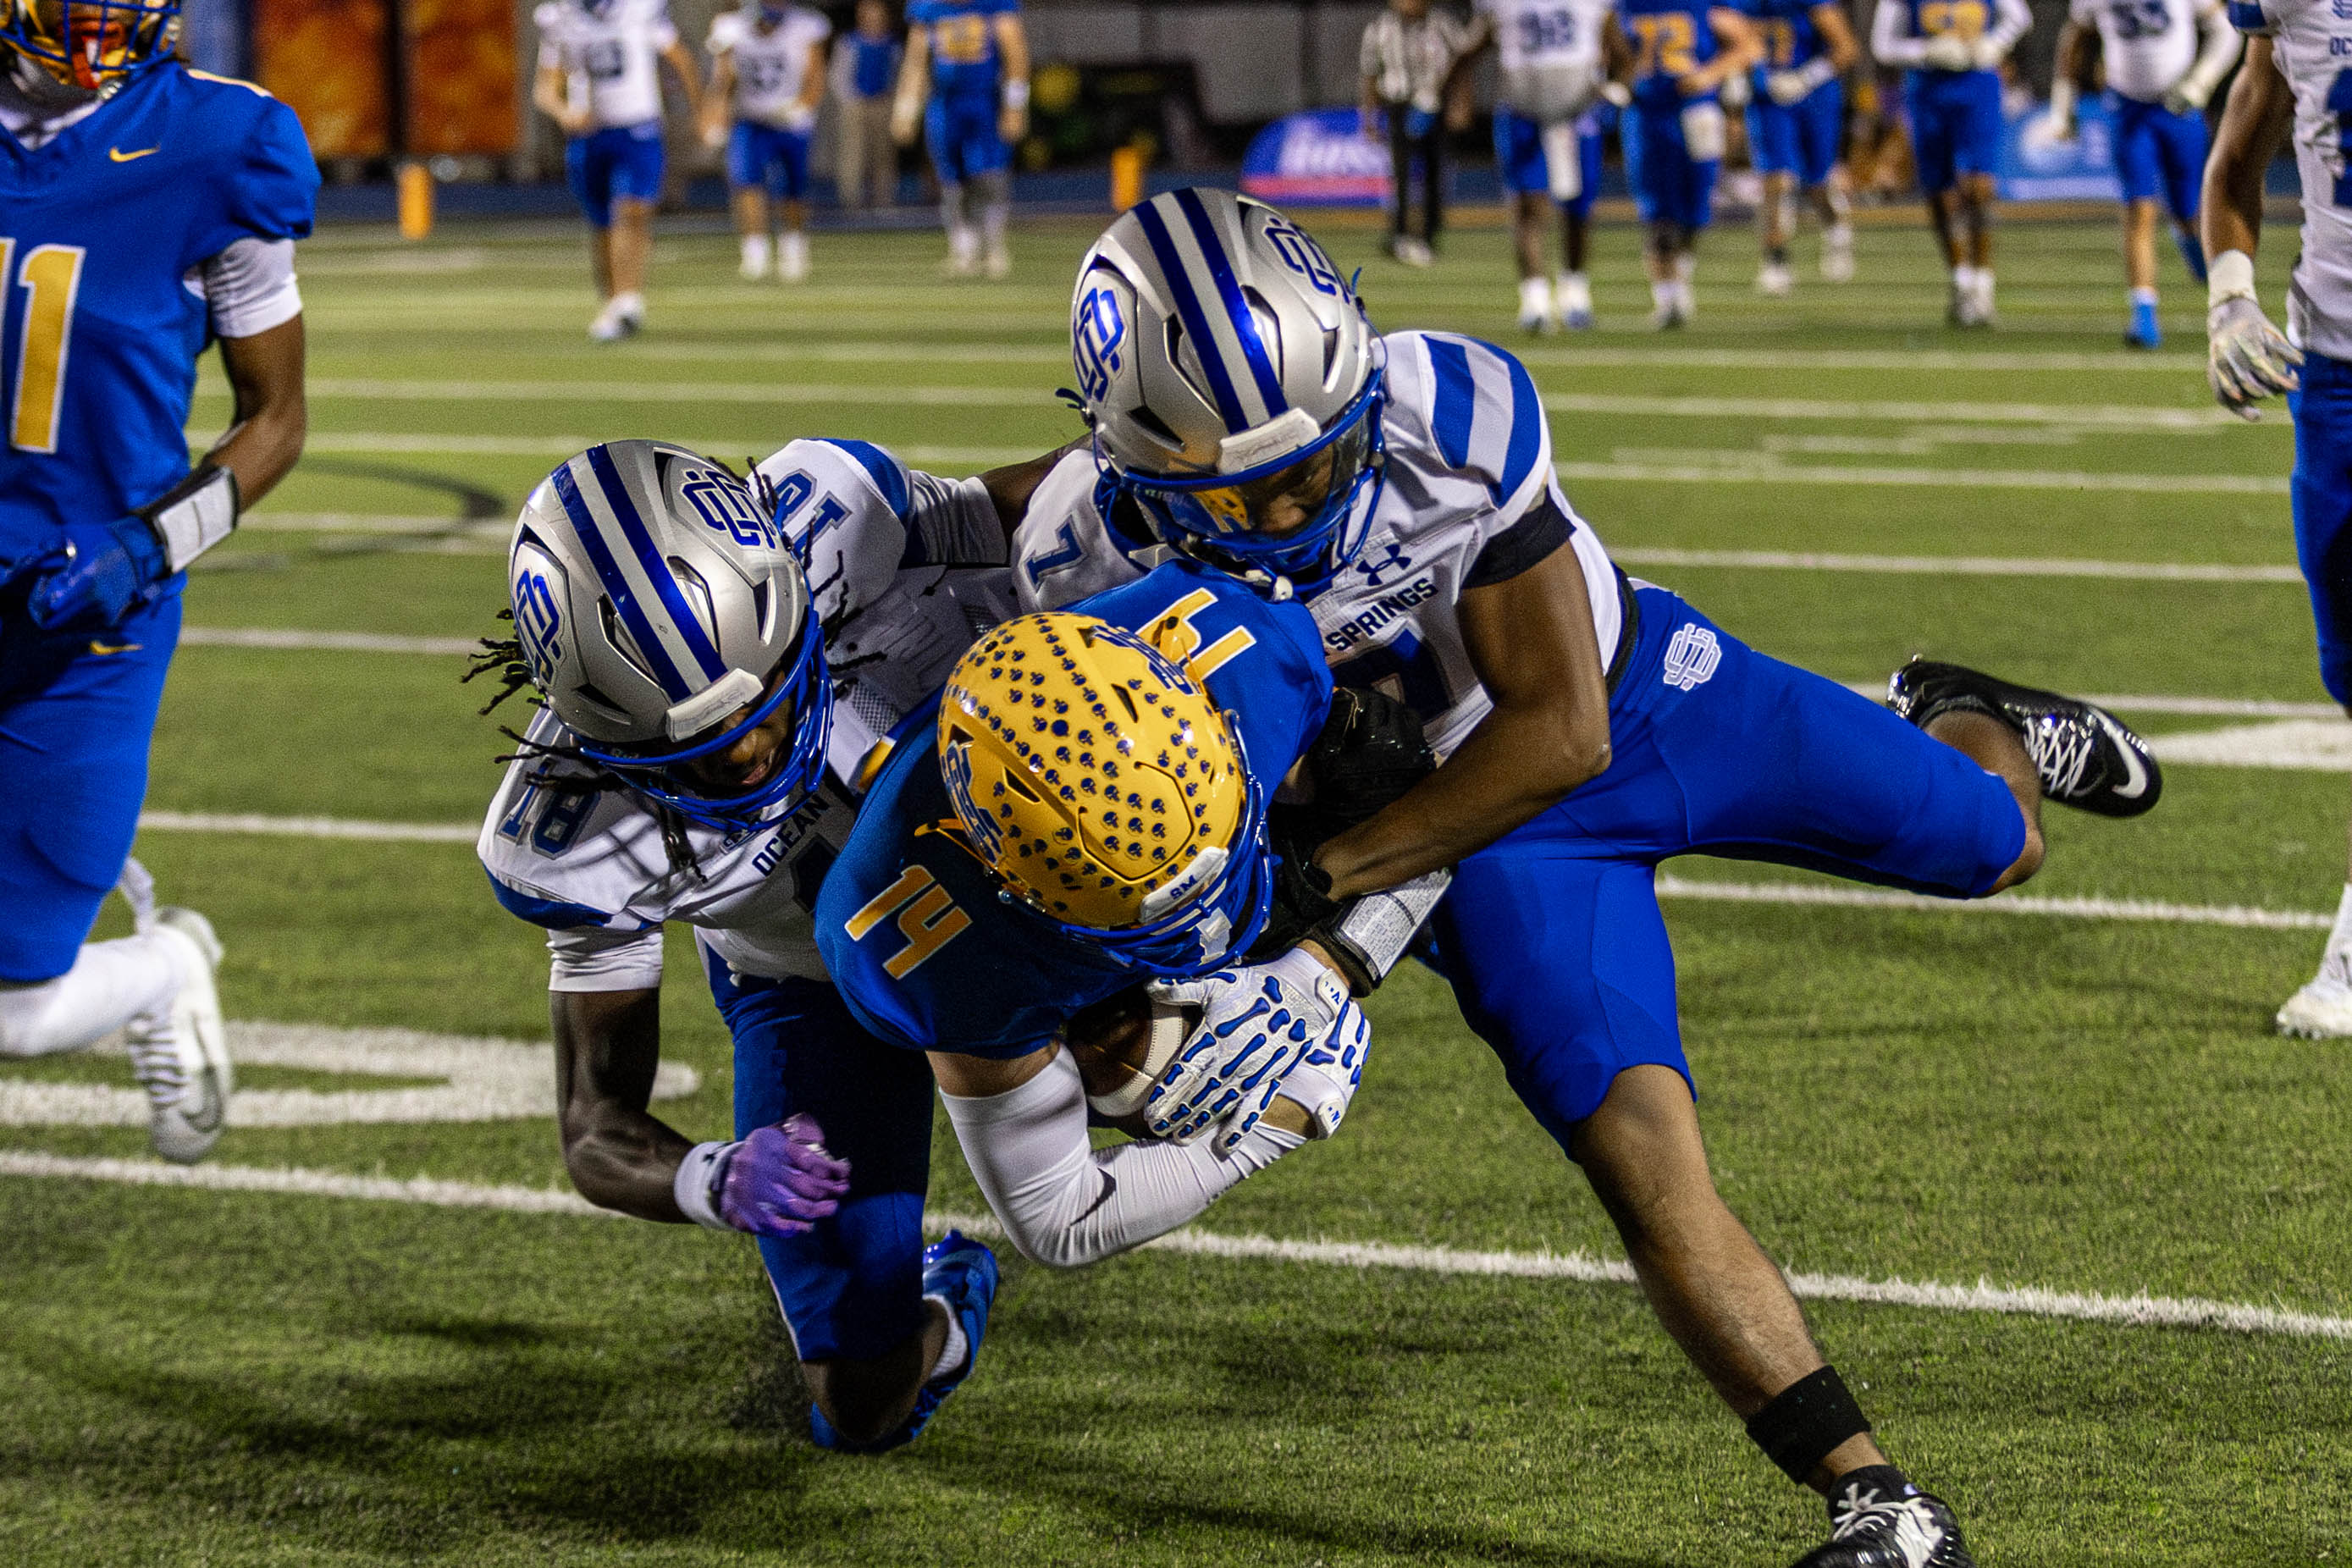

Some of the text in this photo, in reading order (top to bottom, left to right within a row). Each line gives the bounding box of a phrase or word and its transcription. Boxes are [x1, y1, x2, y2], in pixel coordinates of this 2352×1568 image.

[0, 236, 86, 455] 1
[1325, 577, 1439, 652] SPRINGS
[751, 793, 831, 877] OCEAN
[843, 864, 974, 980] 14
[1169, 874, 1199, 899] SM
